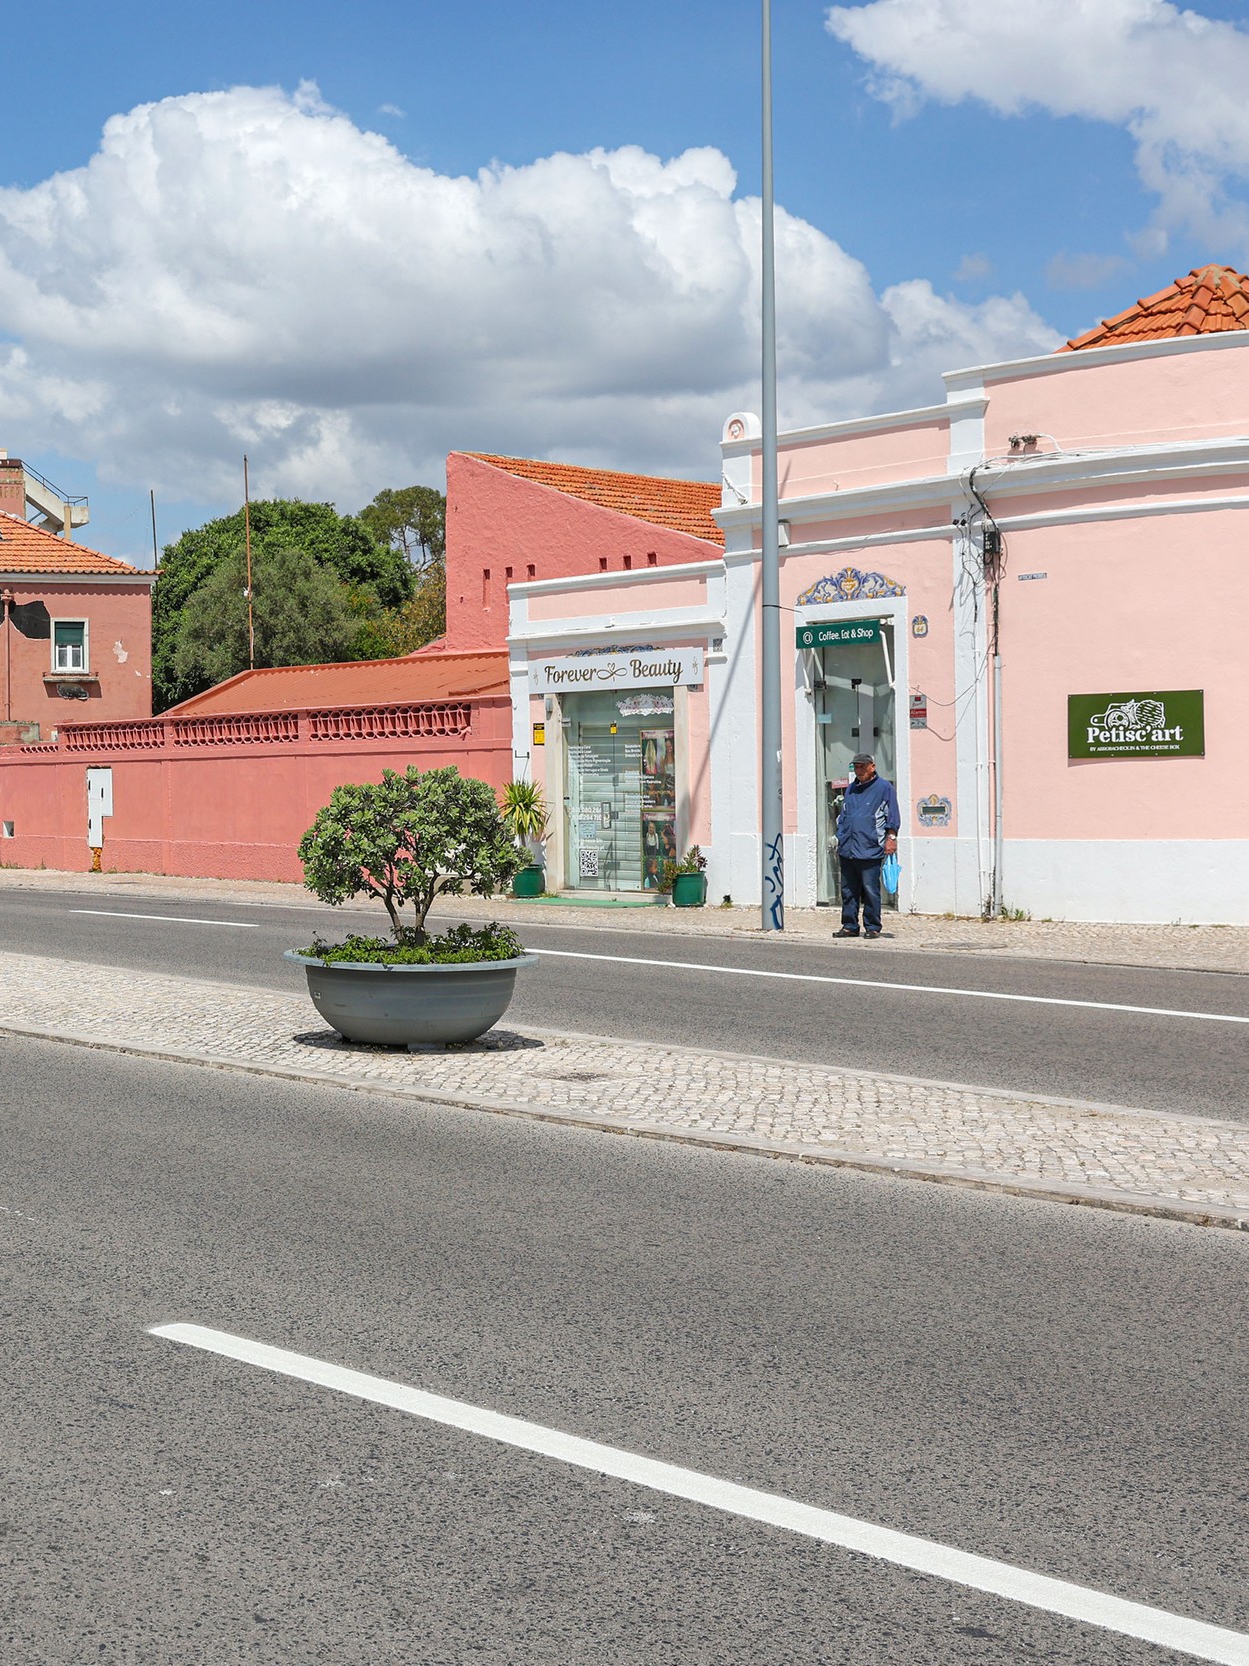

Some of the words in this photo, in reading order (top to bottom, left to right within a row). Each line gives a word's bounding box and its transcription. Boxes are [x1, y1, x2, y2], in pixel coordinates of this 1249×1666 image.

[851, 629, 857, 638] &
[857, 628, 874, 639] Shop
[544, 665, 597, 684] Forever
[629, 659, 684, 684] Beauty
[1086, 725, 1184, 744] Petisc'art
